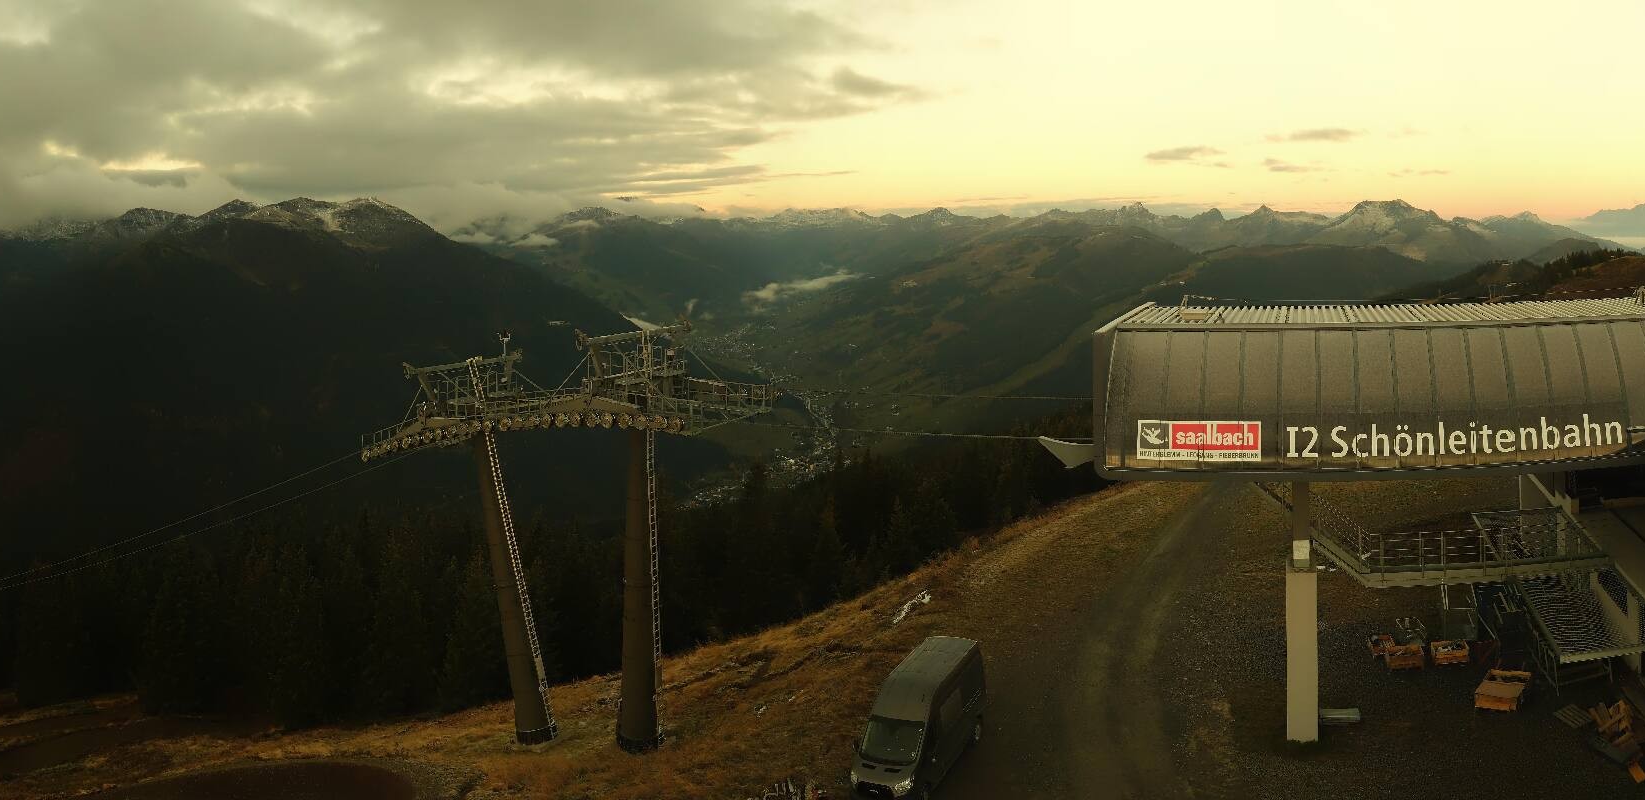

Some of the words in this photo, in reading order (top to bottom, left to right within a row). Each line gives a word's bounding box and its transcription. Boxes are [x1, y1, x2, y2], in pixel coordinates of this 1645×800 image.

[1175, 423, 1254, 446] saalbach
[1286, 425, 1319, 458] I2
[1330, 413, 1623, 458] Schönleitenbahn
